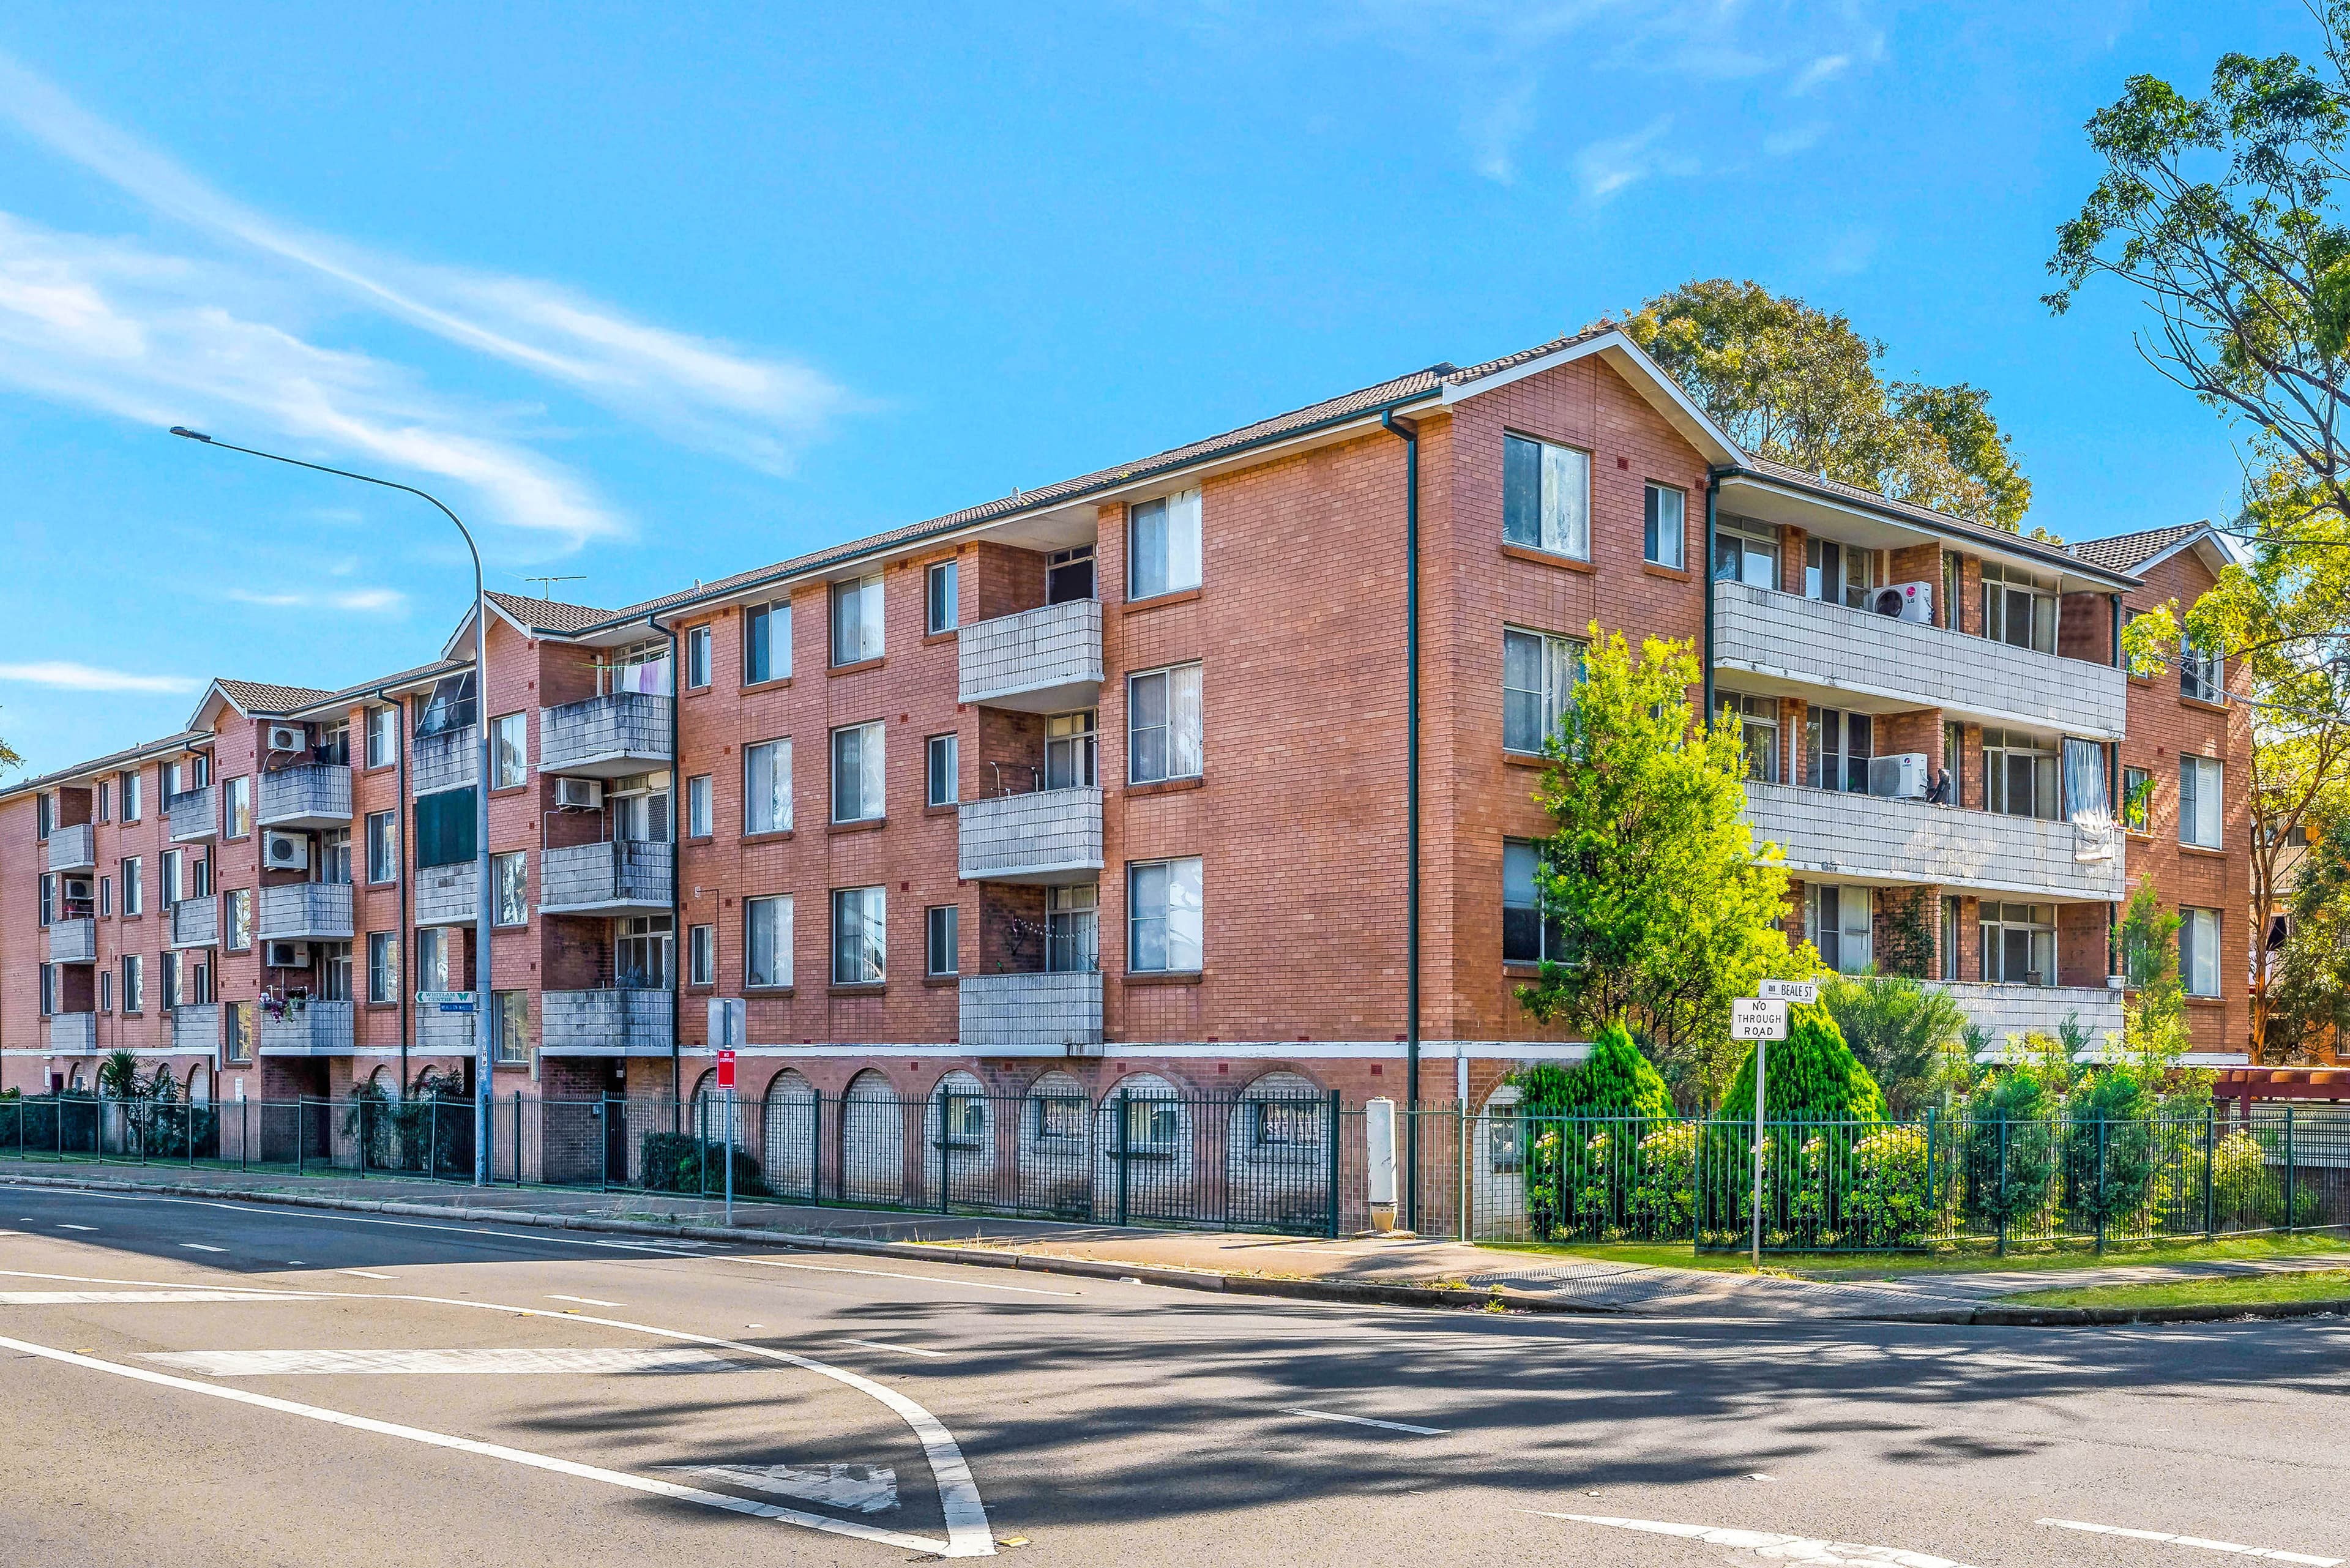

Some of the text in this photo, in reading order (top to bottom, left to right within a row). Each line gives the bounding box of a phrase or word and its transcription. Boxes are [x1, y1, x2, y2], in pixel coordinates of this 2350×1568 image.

[1781, 984, 1813, 998] BEALE ST
[1737, 1014, 1781, 1023] THROUGH
[1744, 1027, 1774, 1036] ROAD
